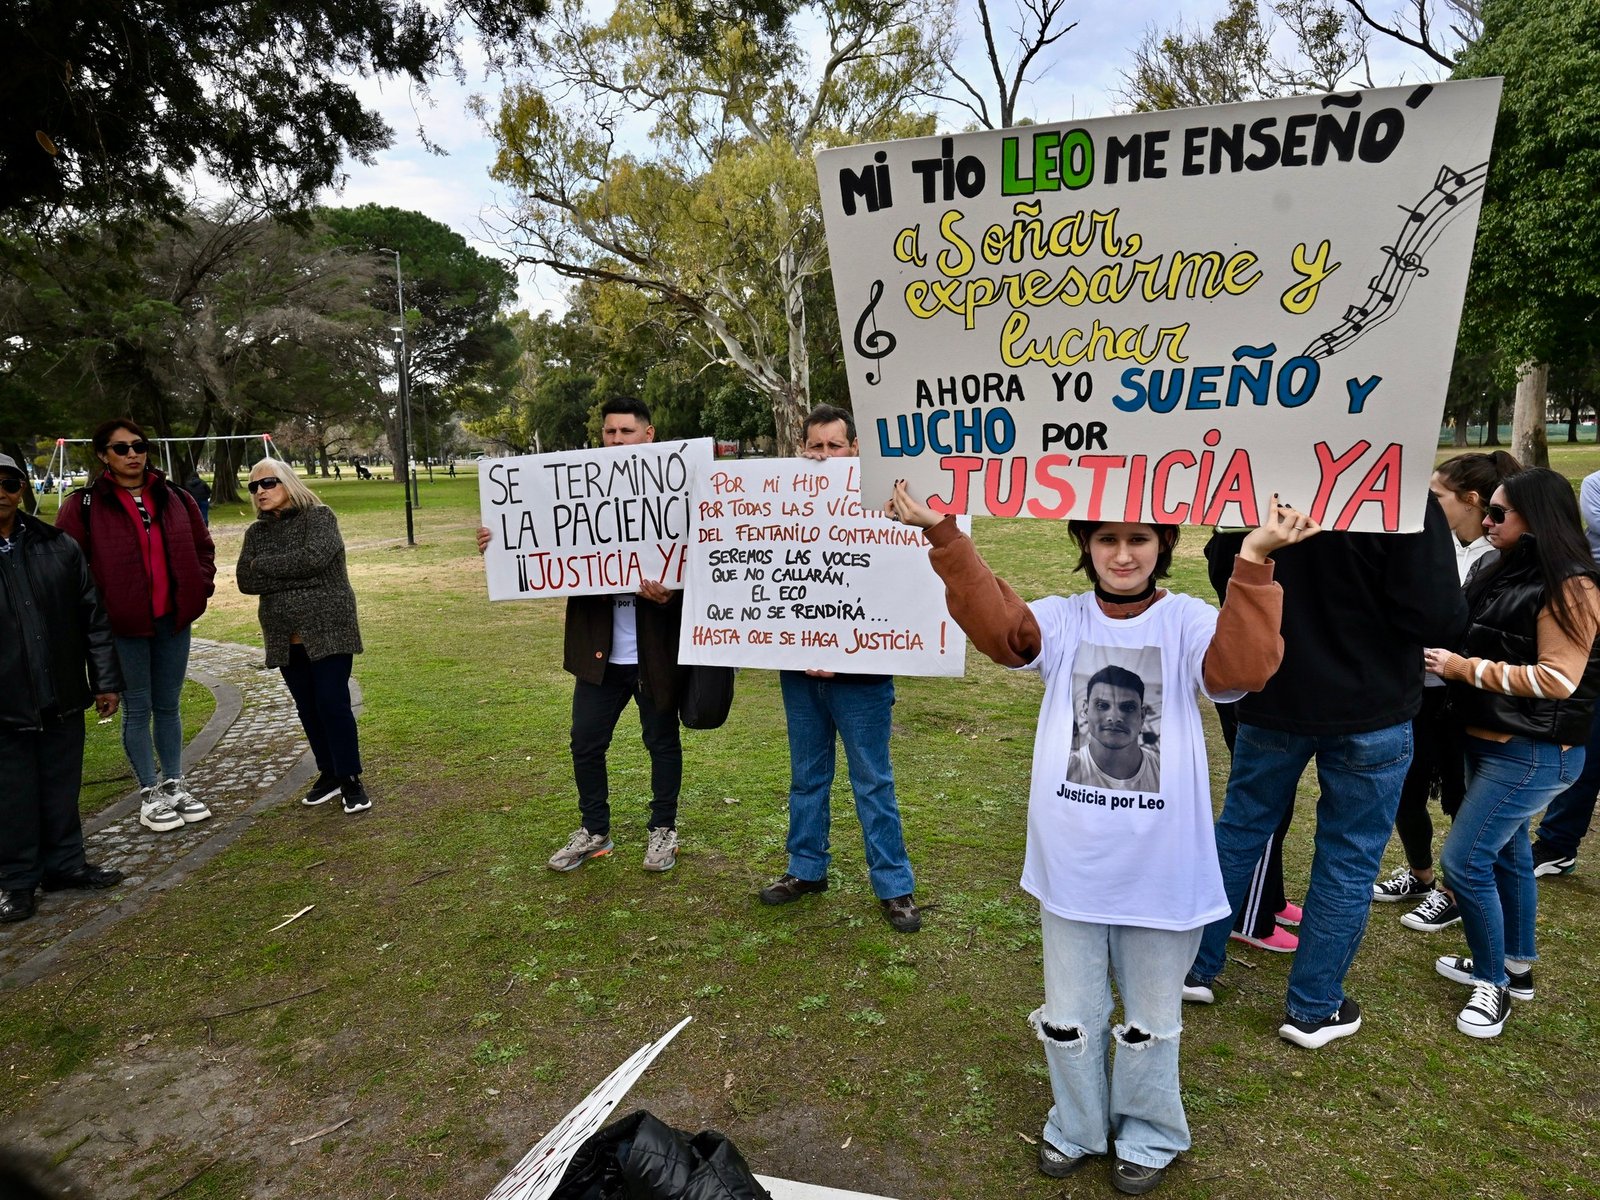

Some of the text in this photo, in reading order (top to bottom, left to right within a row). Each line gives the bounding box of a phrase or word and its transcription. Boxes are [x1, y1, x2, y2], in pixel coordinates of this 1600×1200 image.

[1000, 127, 1095, 197] LEO
[1103, 129, 1171, 185] ME
[1181, 83, 1434, 176] ENSEÑÓ
[893, 199, 1142, 278] a Soñar,
[904, 238, 1342, 331] expresarme y
[999, 310, 1191, 368] luchar
[915, 342, 1383, 415] AHORA YO SUEÑO Y
[876, 406, 1109, 458] LUCHO POR
[488, 442, 689, 506] SE TERMINÓ
[925, 427, 1404, 533] JUSTICIA YA
[501, 490, 690, 551] LA PACIENCI
[698, 501, 725, 522] POR
[727, 498, 772, 517] TODAS
[781, 501, 814, 518] LAS
[698, 523, 932, 547] DEL FENTANILO CONTAMINAD
[708, 548, 872, 568] SEREMOS LAS VOCES
[711, 565, 850, 588] QUE NO CALLARÁN,
[706, 603, 735, 621] QUE
[740, 605, 762, 622] NO
[766, 605, 786, 619] SE
[751, 584, 807, 602] EL ECO
[692, 625, 741, 645] HASTA
[747, 629, 773, 645] QUE
[778, 631, 796, 645] SE
[801, 630, 839, 648] HAGA
[1056, 783, 1165, 811] Justicia por Leo
